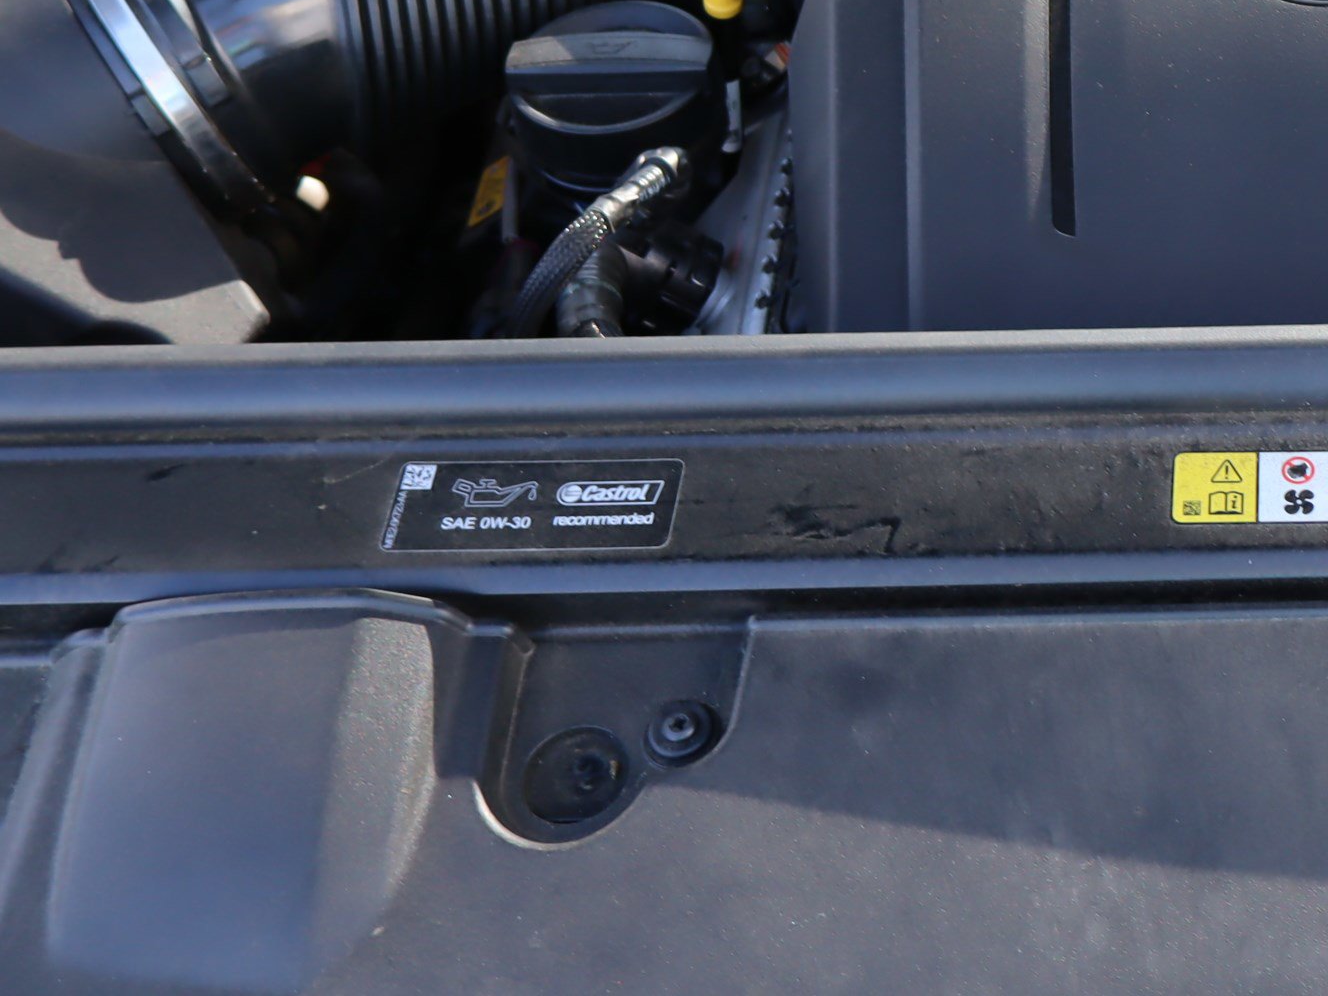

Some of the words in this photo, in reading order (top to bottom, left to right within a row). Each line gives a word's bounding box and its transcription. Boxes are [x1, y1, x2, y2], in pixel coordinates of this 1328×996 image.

[580, 484, 650, 502] Castrol
[440, 516, 475, 530] SAE
[480, 516, 532, 530] 0W-30
[552, 512, 655, 526] recommended
